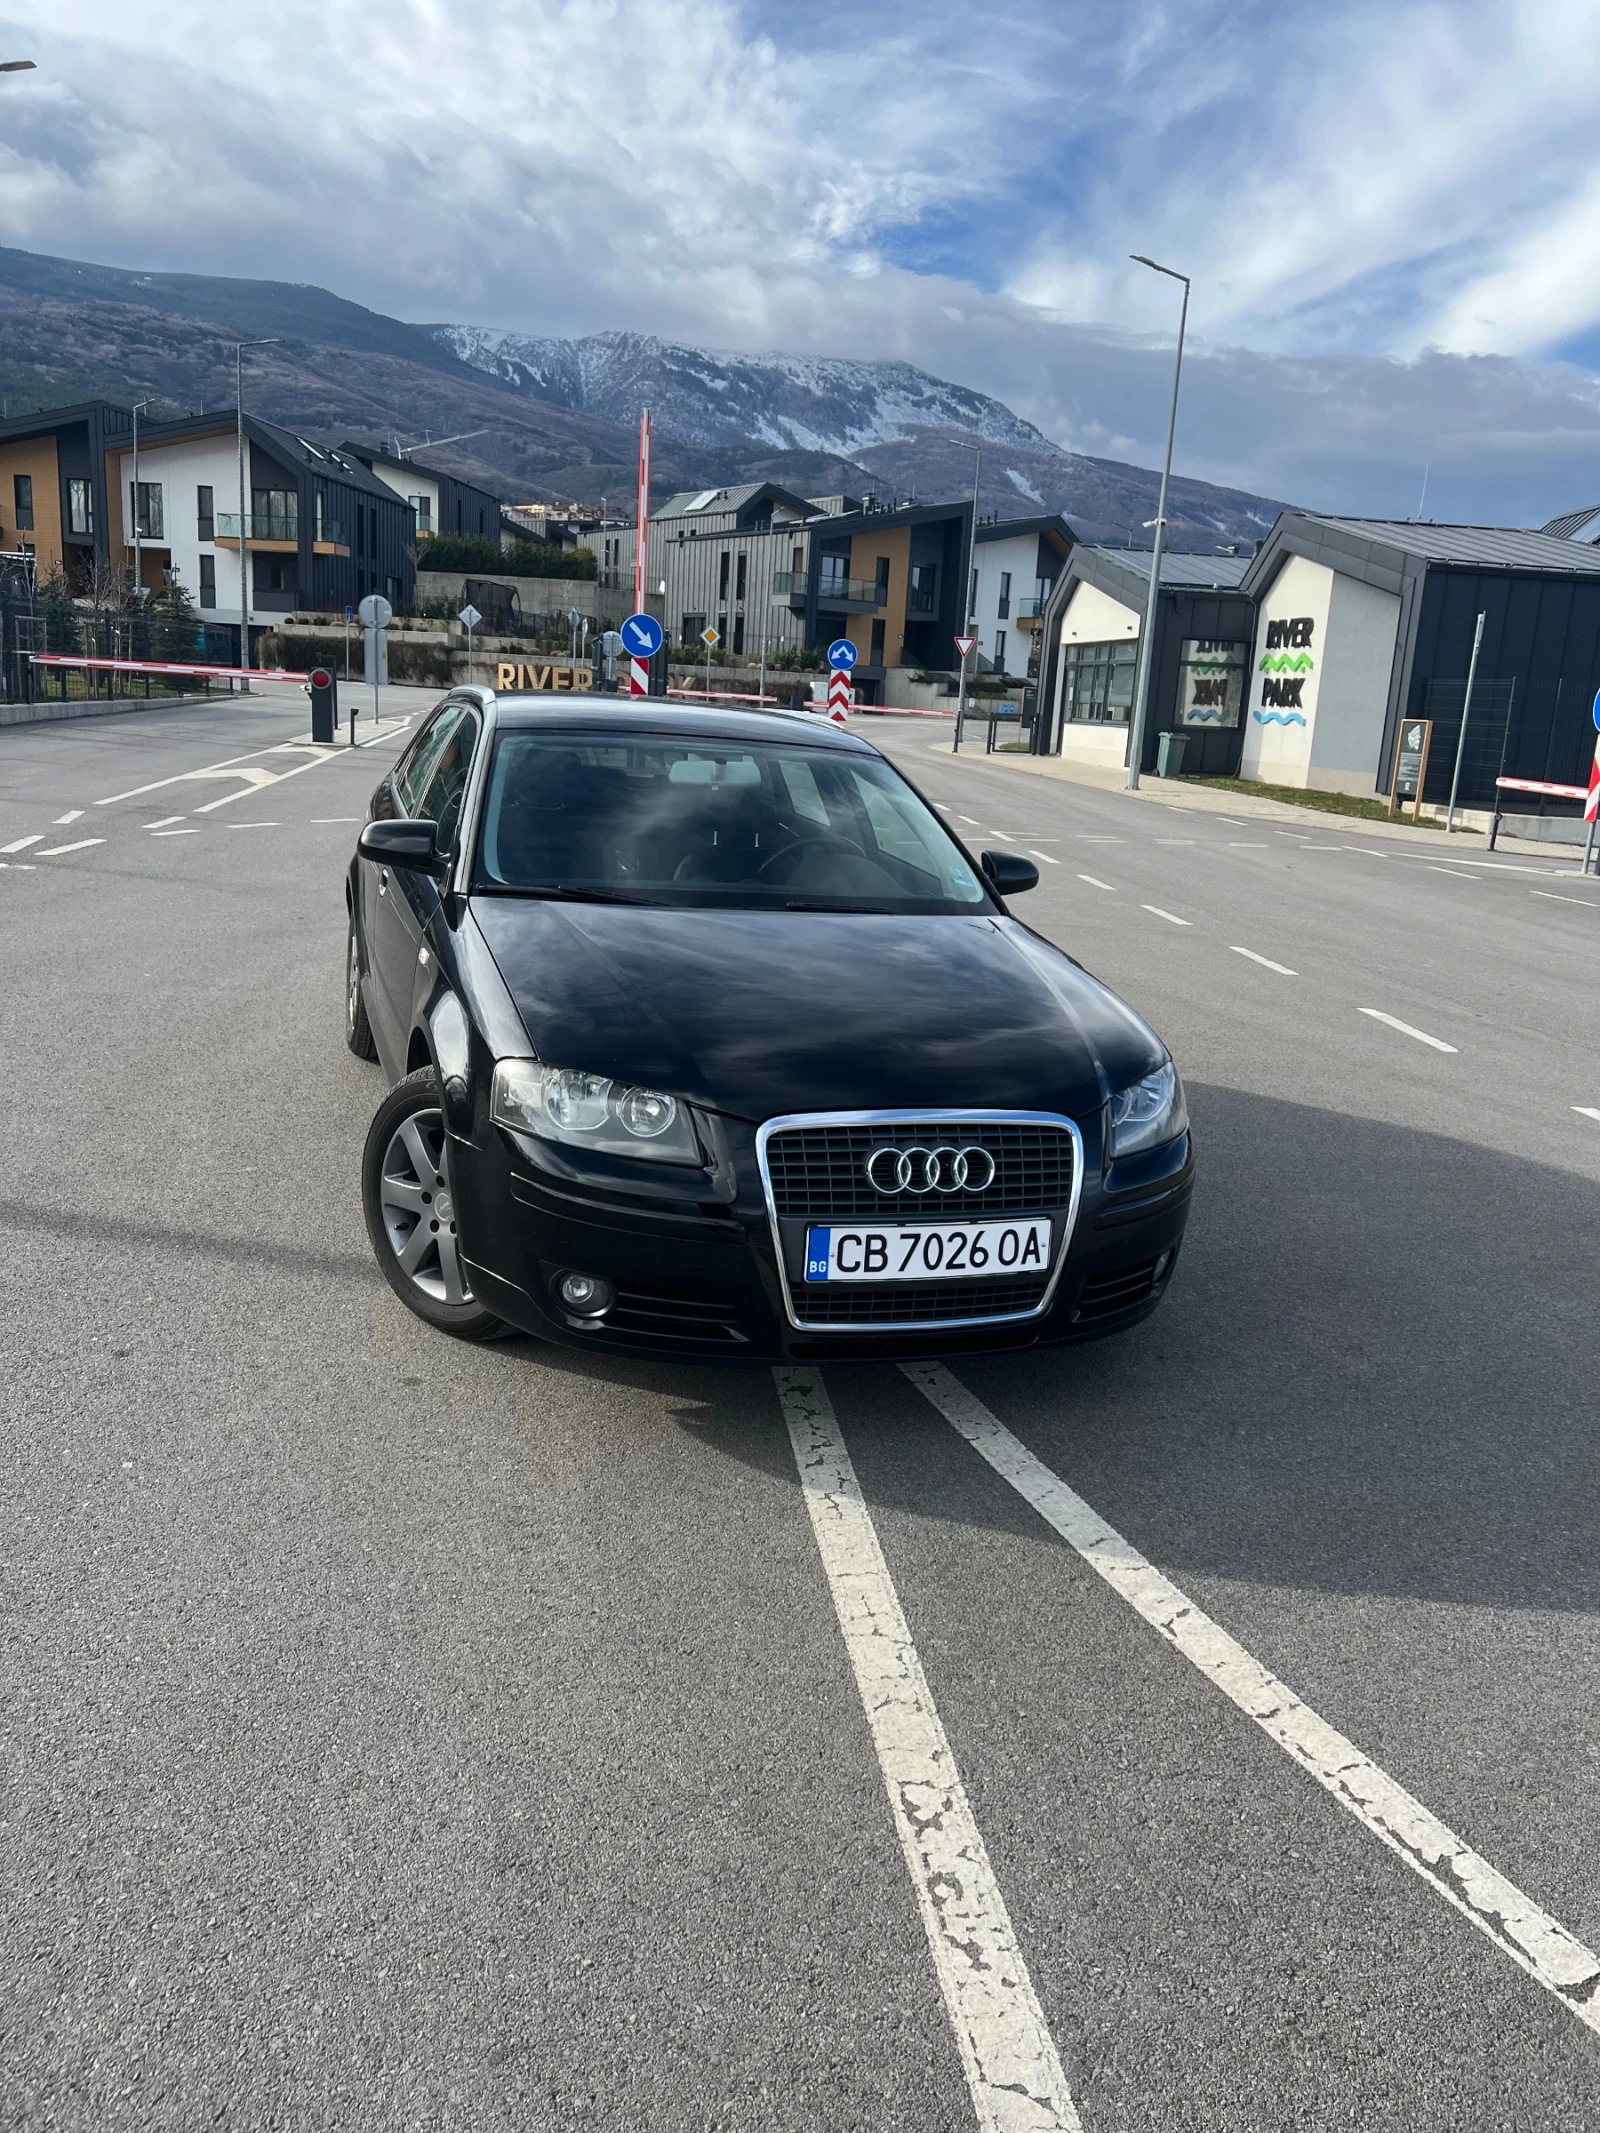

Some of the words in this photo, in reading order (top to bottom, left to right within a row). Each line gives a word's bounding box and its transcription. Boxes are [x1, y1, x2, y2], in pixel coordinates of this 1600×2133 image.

[1266, 617, 1314, 650] RIVER
[498, 663, 593, 692] RIVER
[1261, 678, 1306, 709] PARK
[836, 1234, 888, 1273] CB
[898, 1230, 989, 1272] 7026
[998, 1226, 1041, 1266] OA
[809, 1261, 827, 1273] BG
